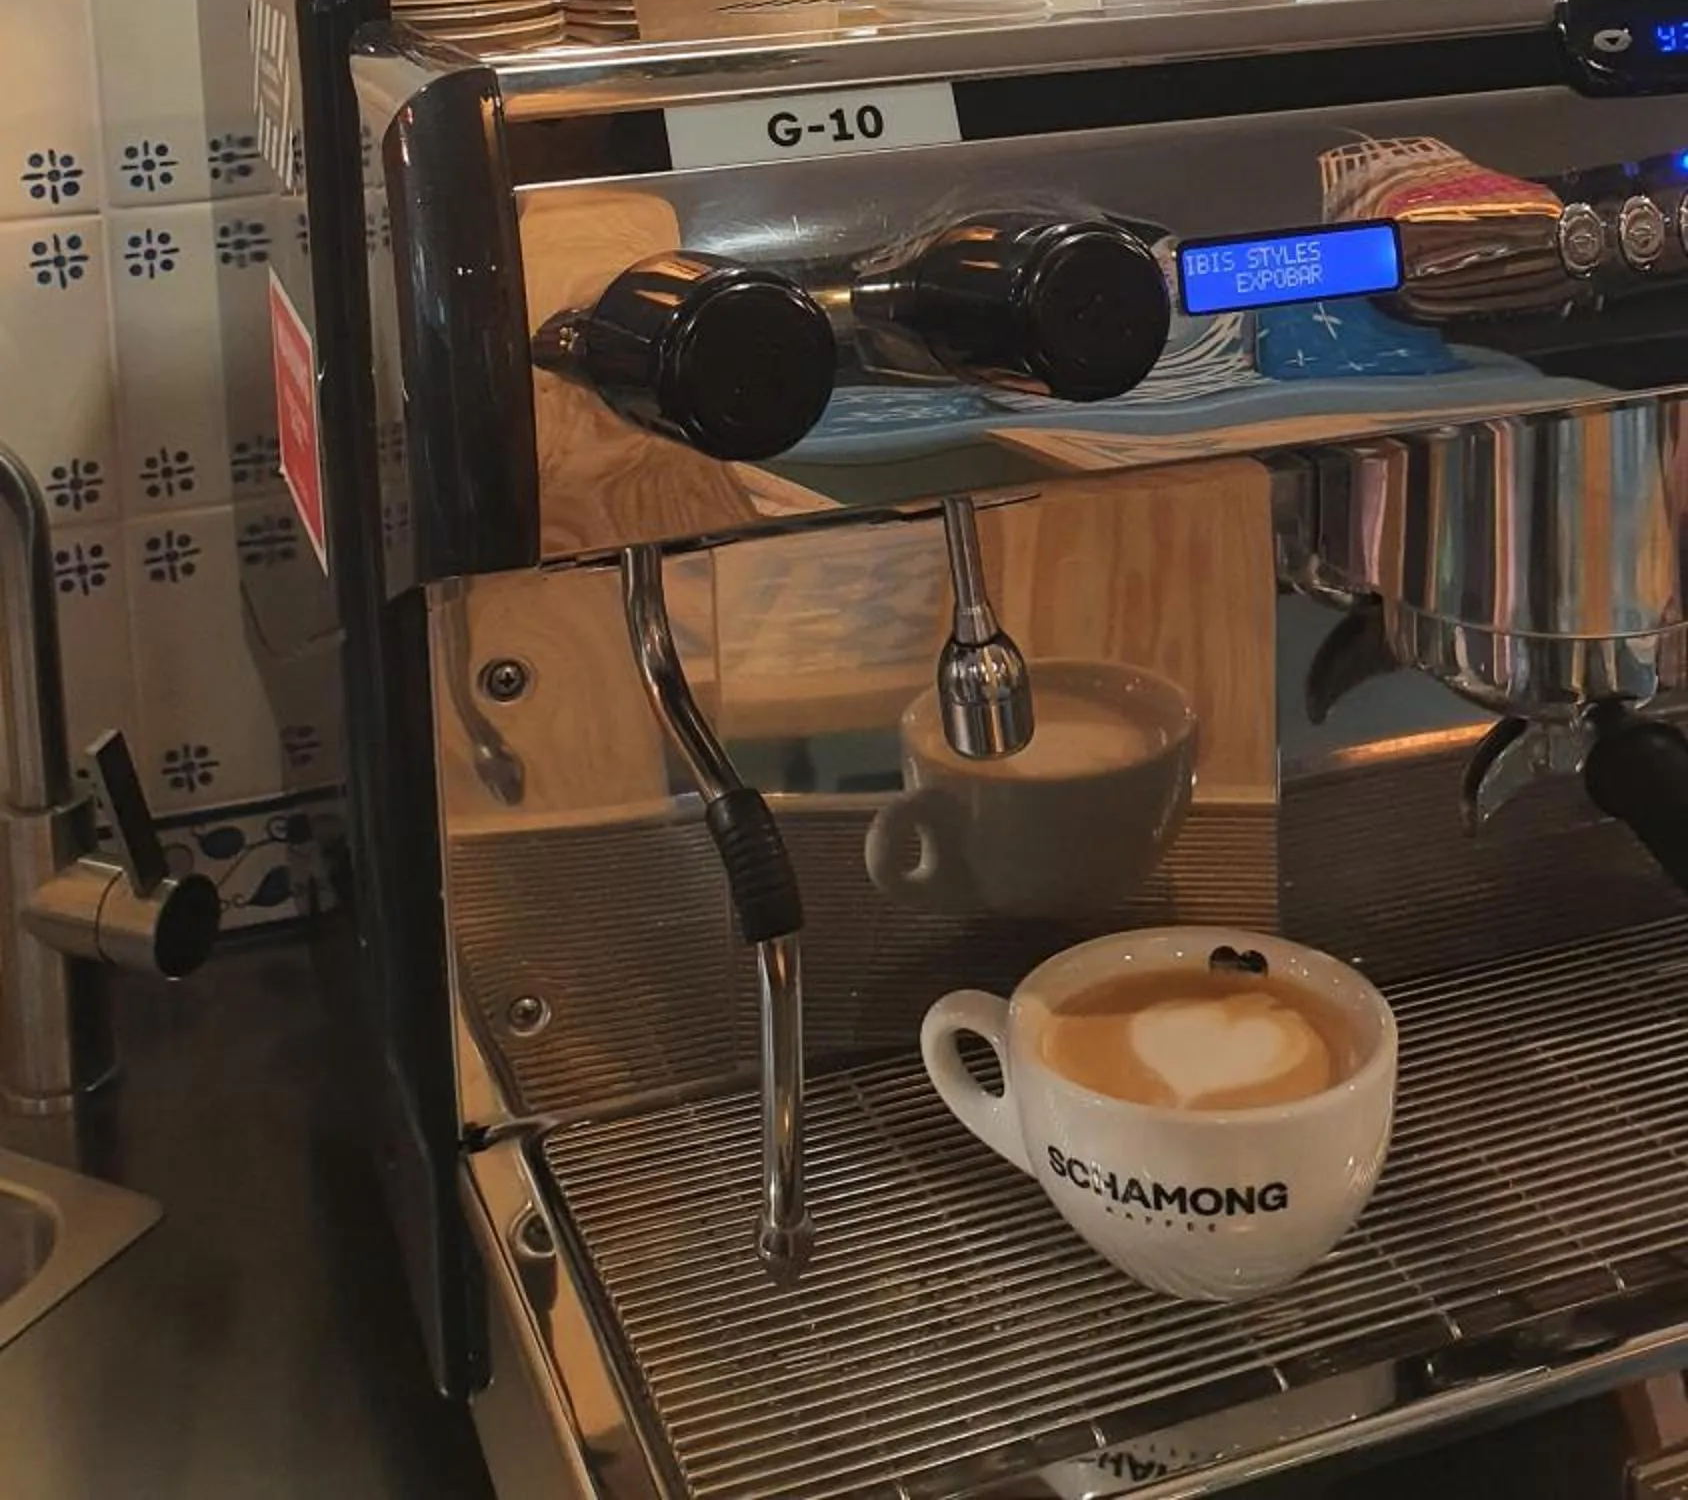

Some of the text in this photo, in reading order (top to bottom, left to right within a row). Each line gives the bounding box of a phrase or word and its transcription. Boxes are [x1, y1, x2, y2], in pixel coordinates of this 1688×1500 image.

[767, 104, 884, 147] G-10
[1185, 241, 1322, 277] IBIS STYLES
[1236, 264, 1324, 293] EXPOBAR
[1047, 1145, 1288, 1216] SCHAMONG
